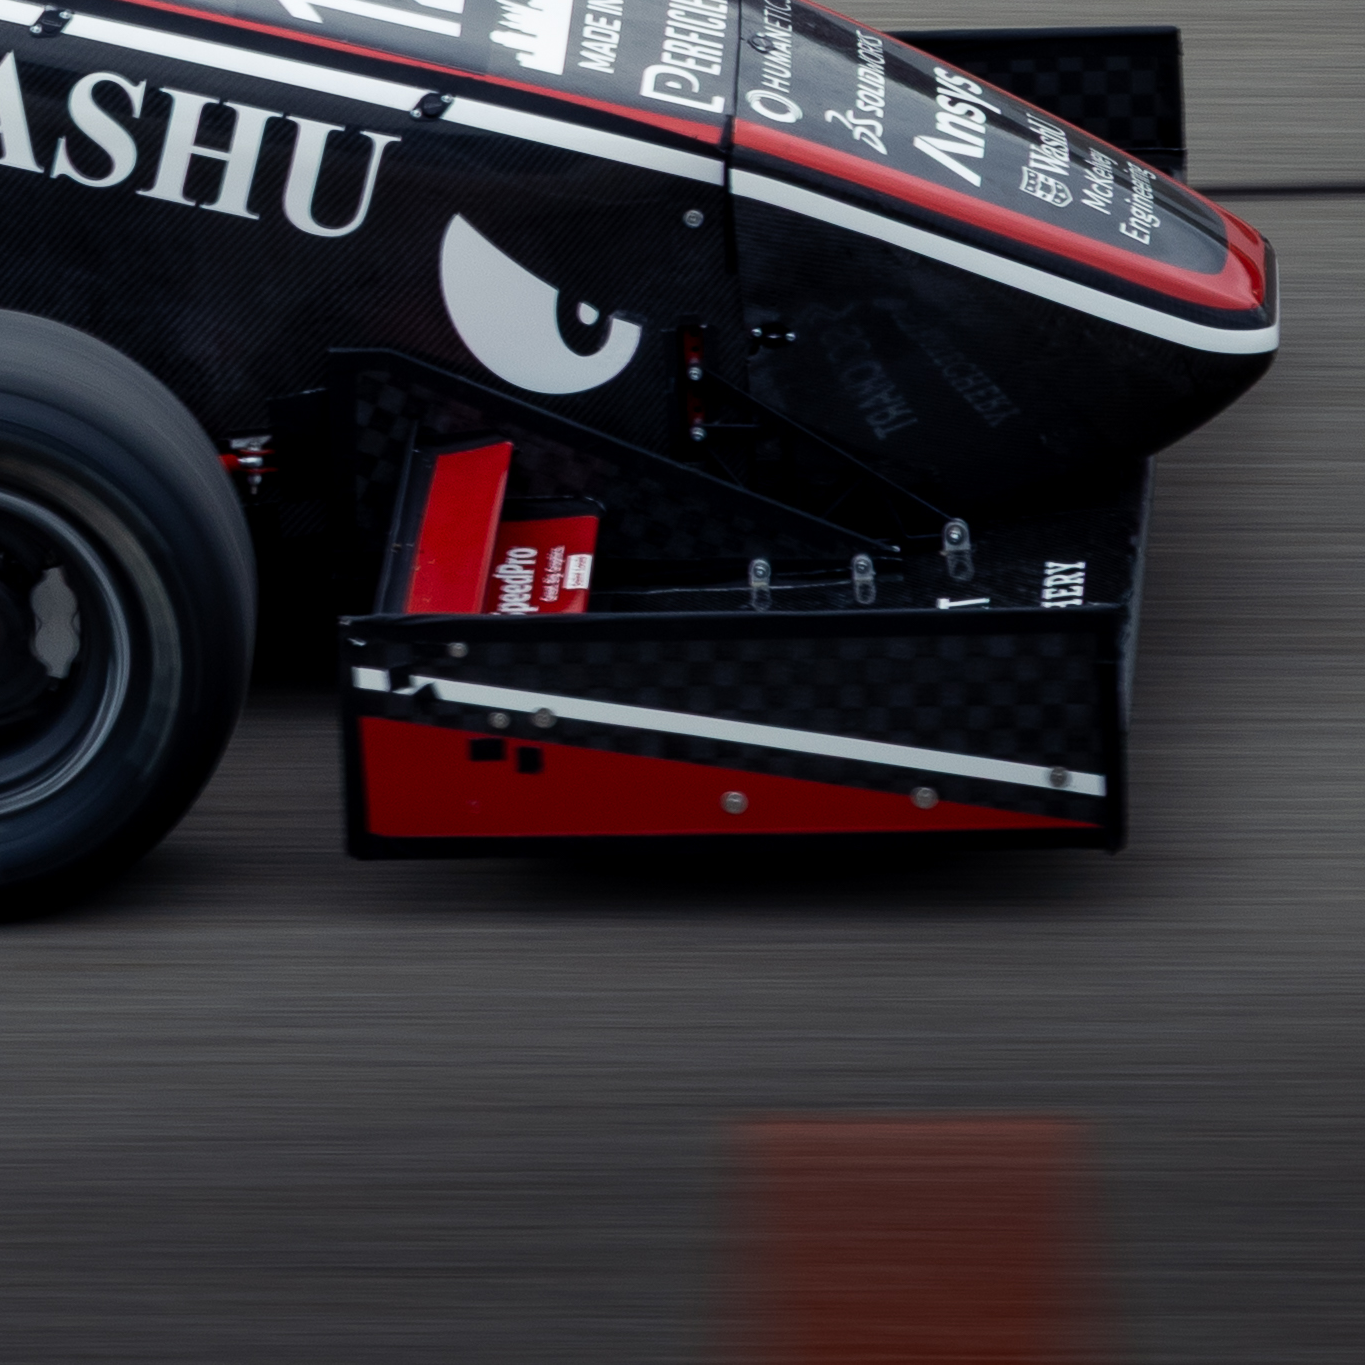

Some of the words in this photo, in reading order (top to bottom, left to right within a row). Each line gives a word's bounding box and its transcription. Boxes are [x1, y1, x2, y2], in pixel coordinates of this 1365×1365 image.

[578, 13, 622, 74] MADE
[855, 29, 886, 119] SOLIDWORKS
[912, 66, 1002, 188] Ansys
[1025, 112, 1070, 176] WashU
[1080, 147, 1119, 216] McKelvey
[1119, 160, 1162, 246] Engineering
[491, 546, 539, 615] peedPro
